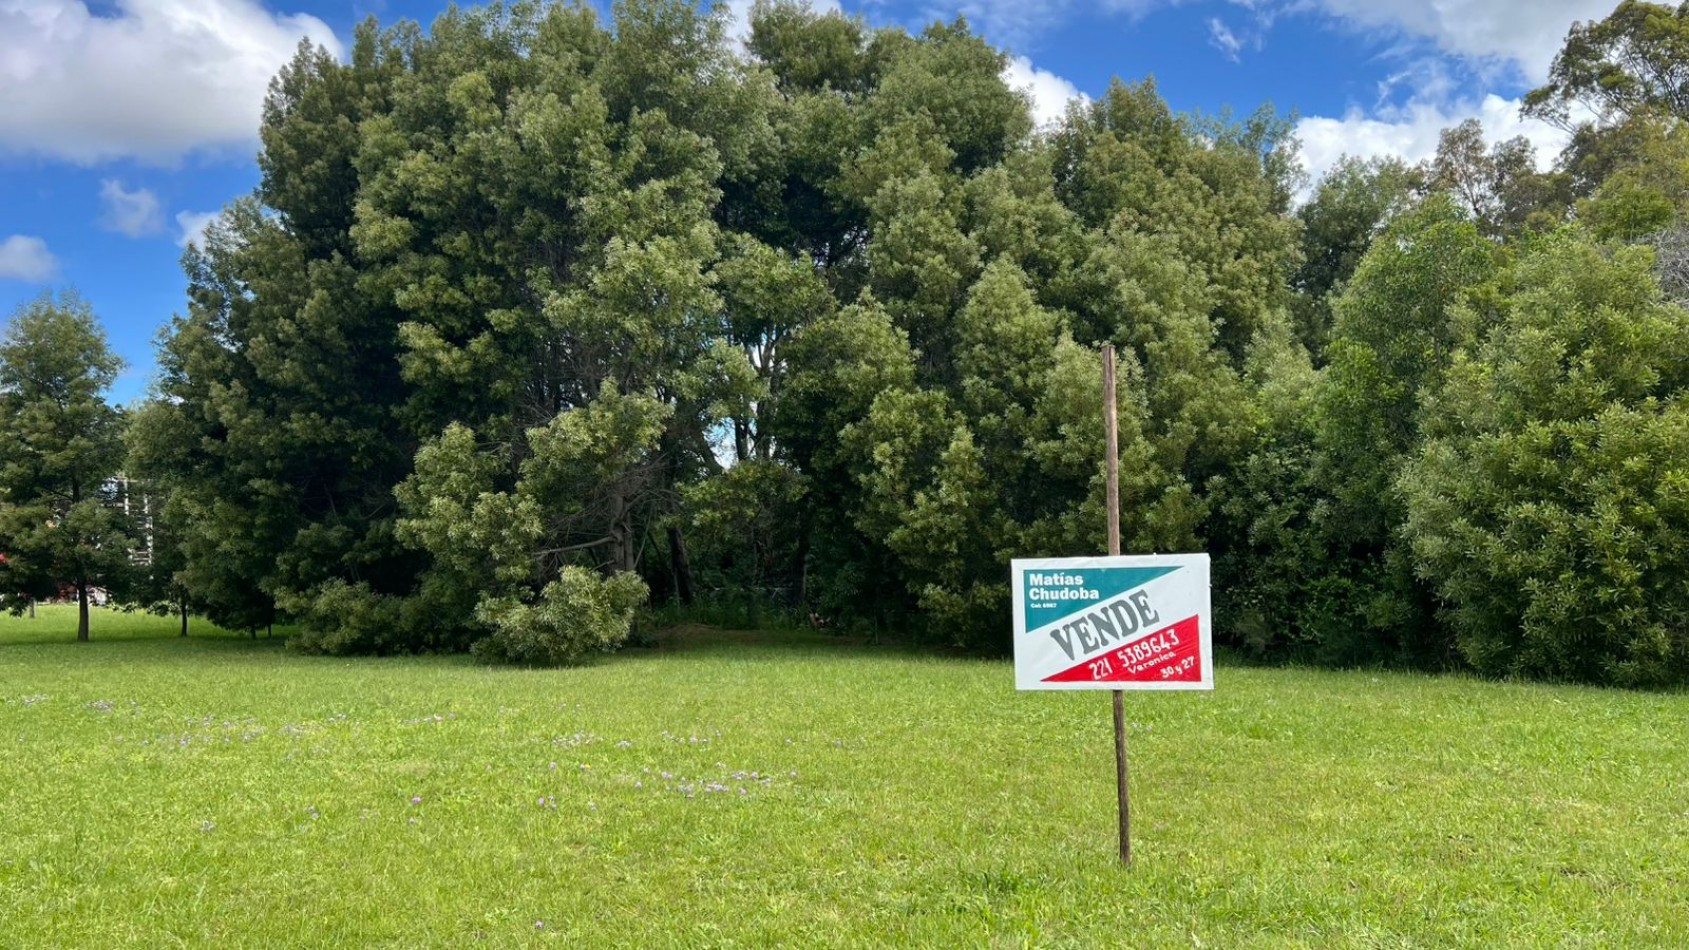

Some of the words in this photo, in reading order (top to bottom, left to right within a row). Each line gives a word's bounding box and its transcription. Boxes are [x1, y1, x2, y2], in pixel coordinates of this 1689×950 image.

[1029, 572, 1084, 586] Matías
[1029, 587, 1100, 600] Chudoba
[1050, 589, 1160, 661] VENDE
[1089, 657, 1113, 680] 221
[1117, 629, 1180, 667] 5389643
[1127, 651, 1176, 675] Veronica
[1160, 666, 1175, 678] 30
[1175, 664, 1183, 675] y
[1181, 655, 1195, 670] 27
